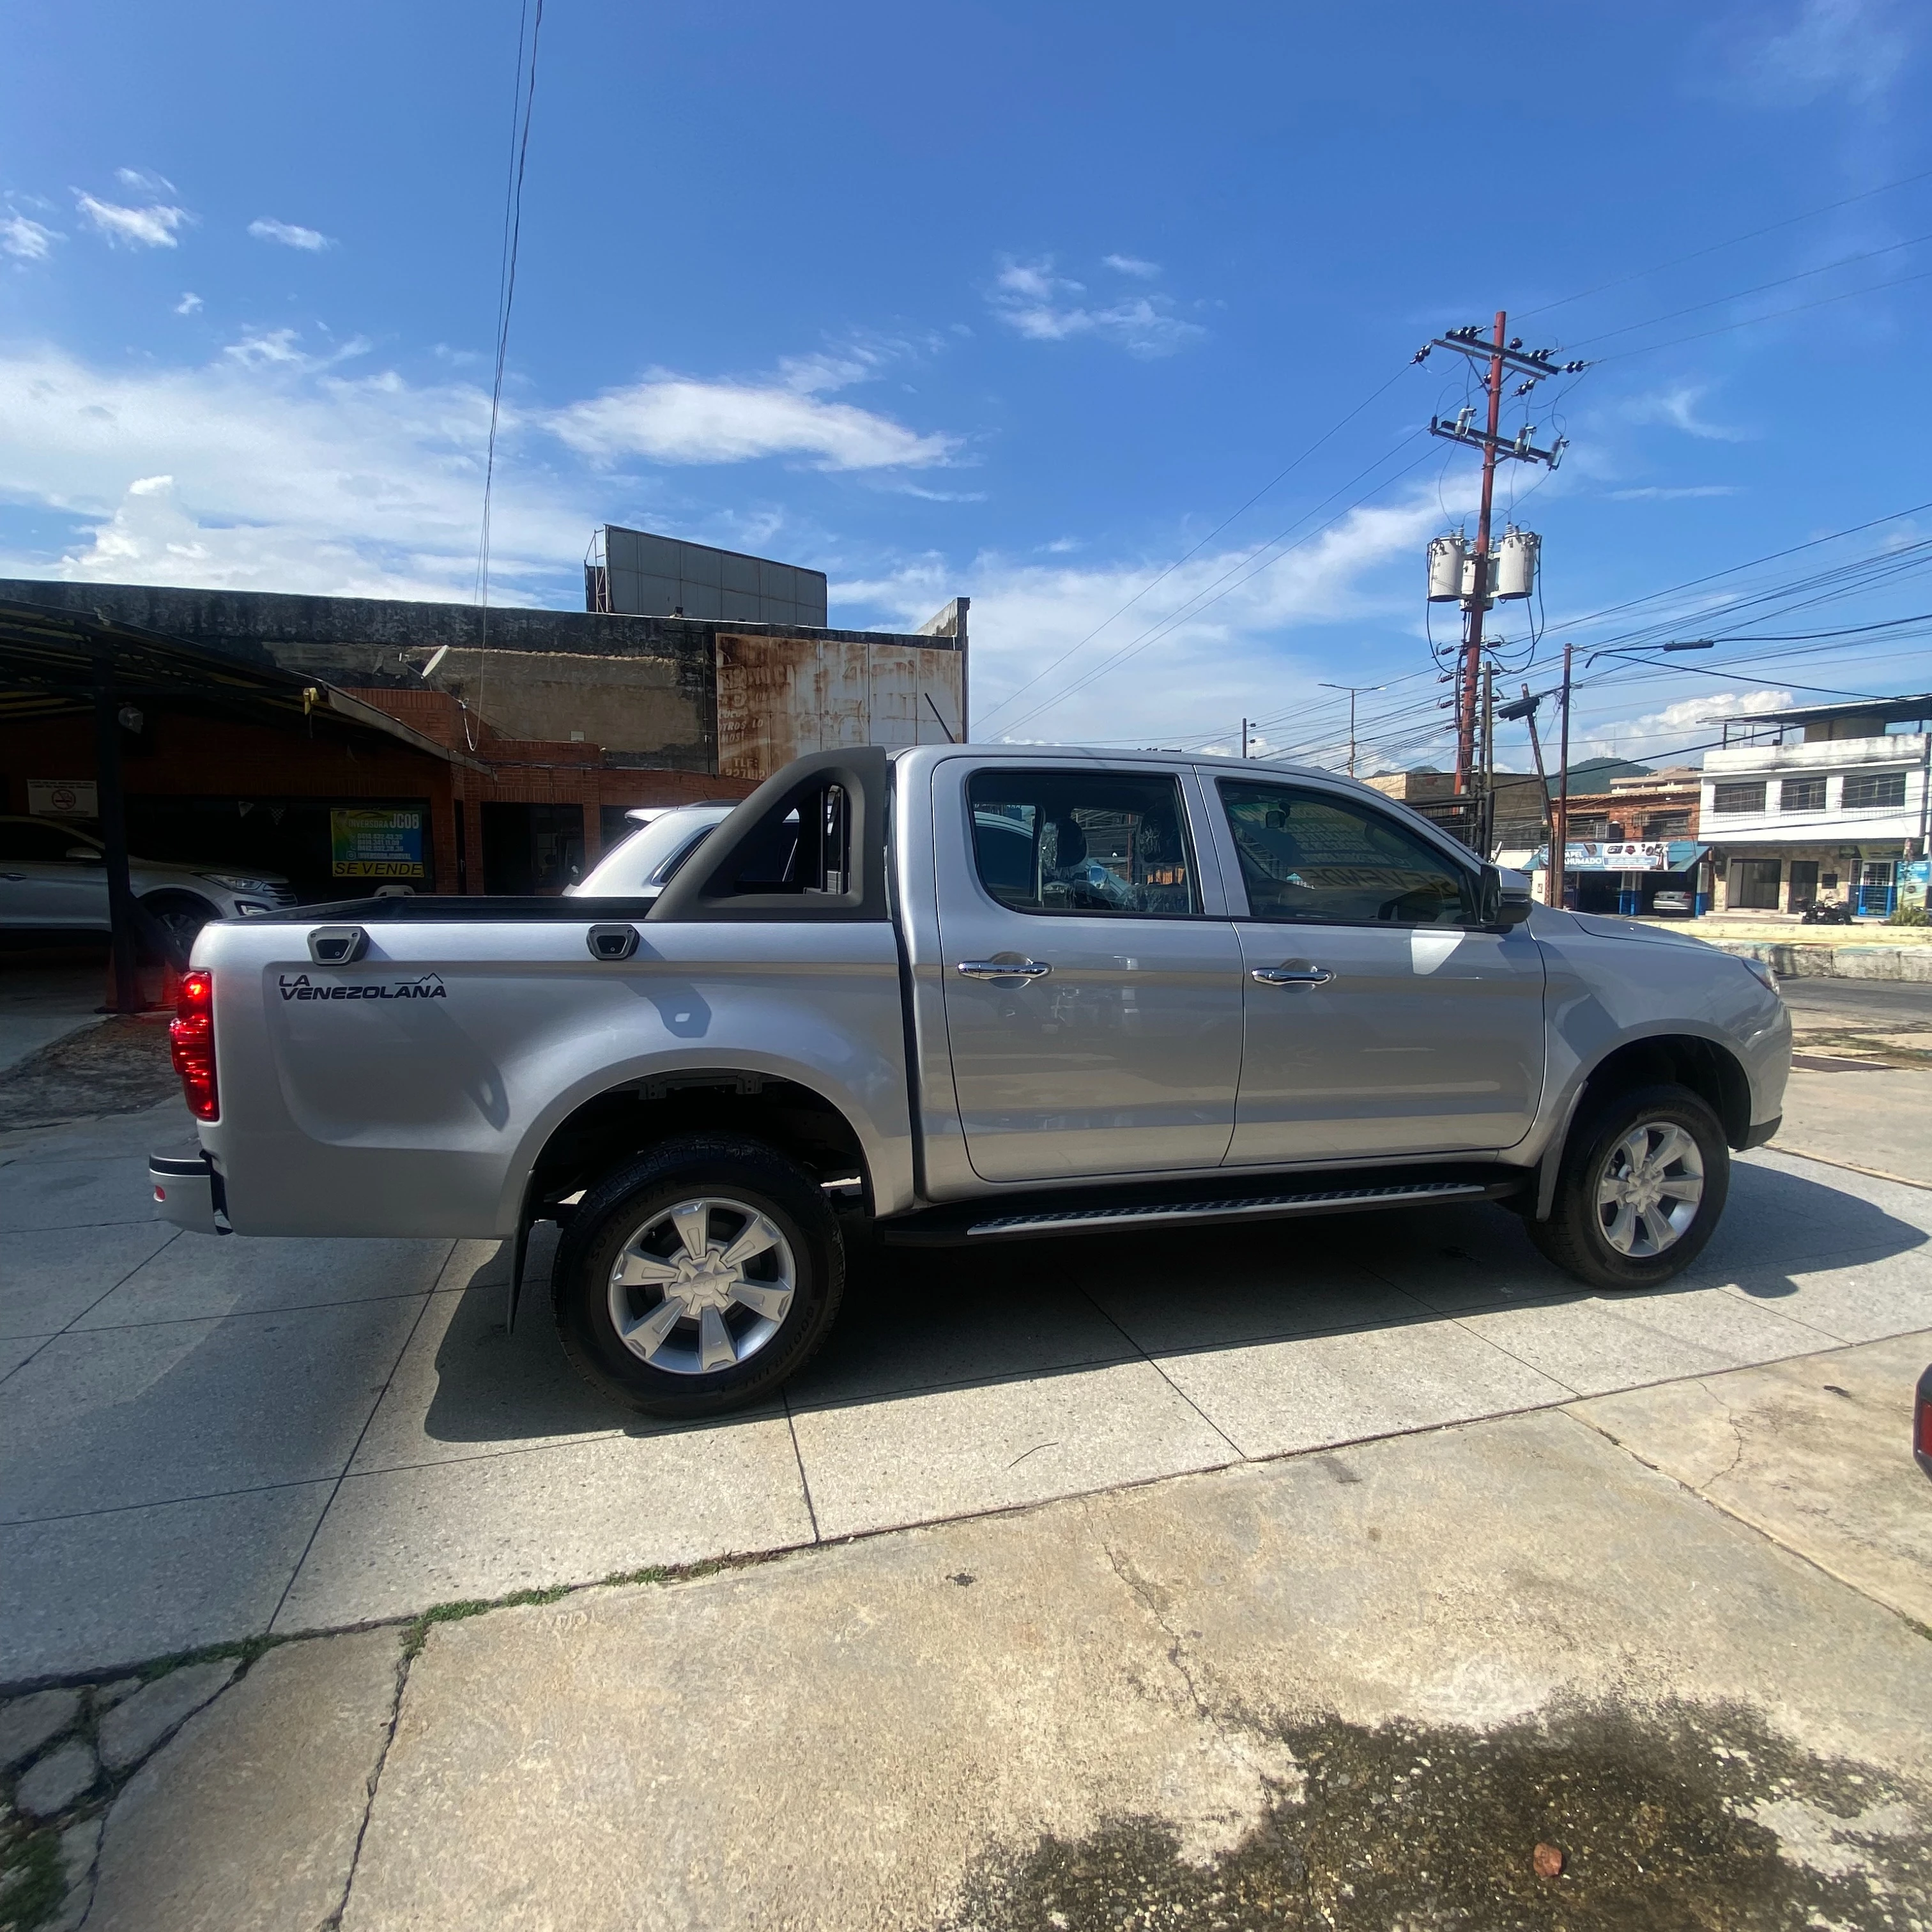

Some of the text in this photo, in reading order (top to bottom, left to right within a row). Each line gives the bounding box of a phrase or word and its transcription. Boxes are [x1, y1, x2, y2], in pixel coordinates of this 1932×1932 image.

[349, 819, 388, 829] INVERSORA
[335, 862, 422, 875] SE VENDE
[279, 974, 310, 987] LA
[280, 986, 447, 1000] VENEZOLANA
